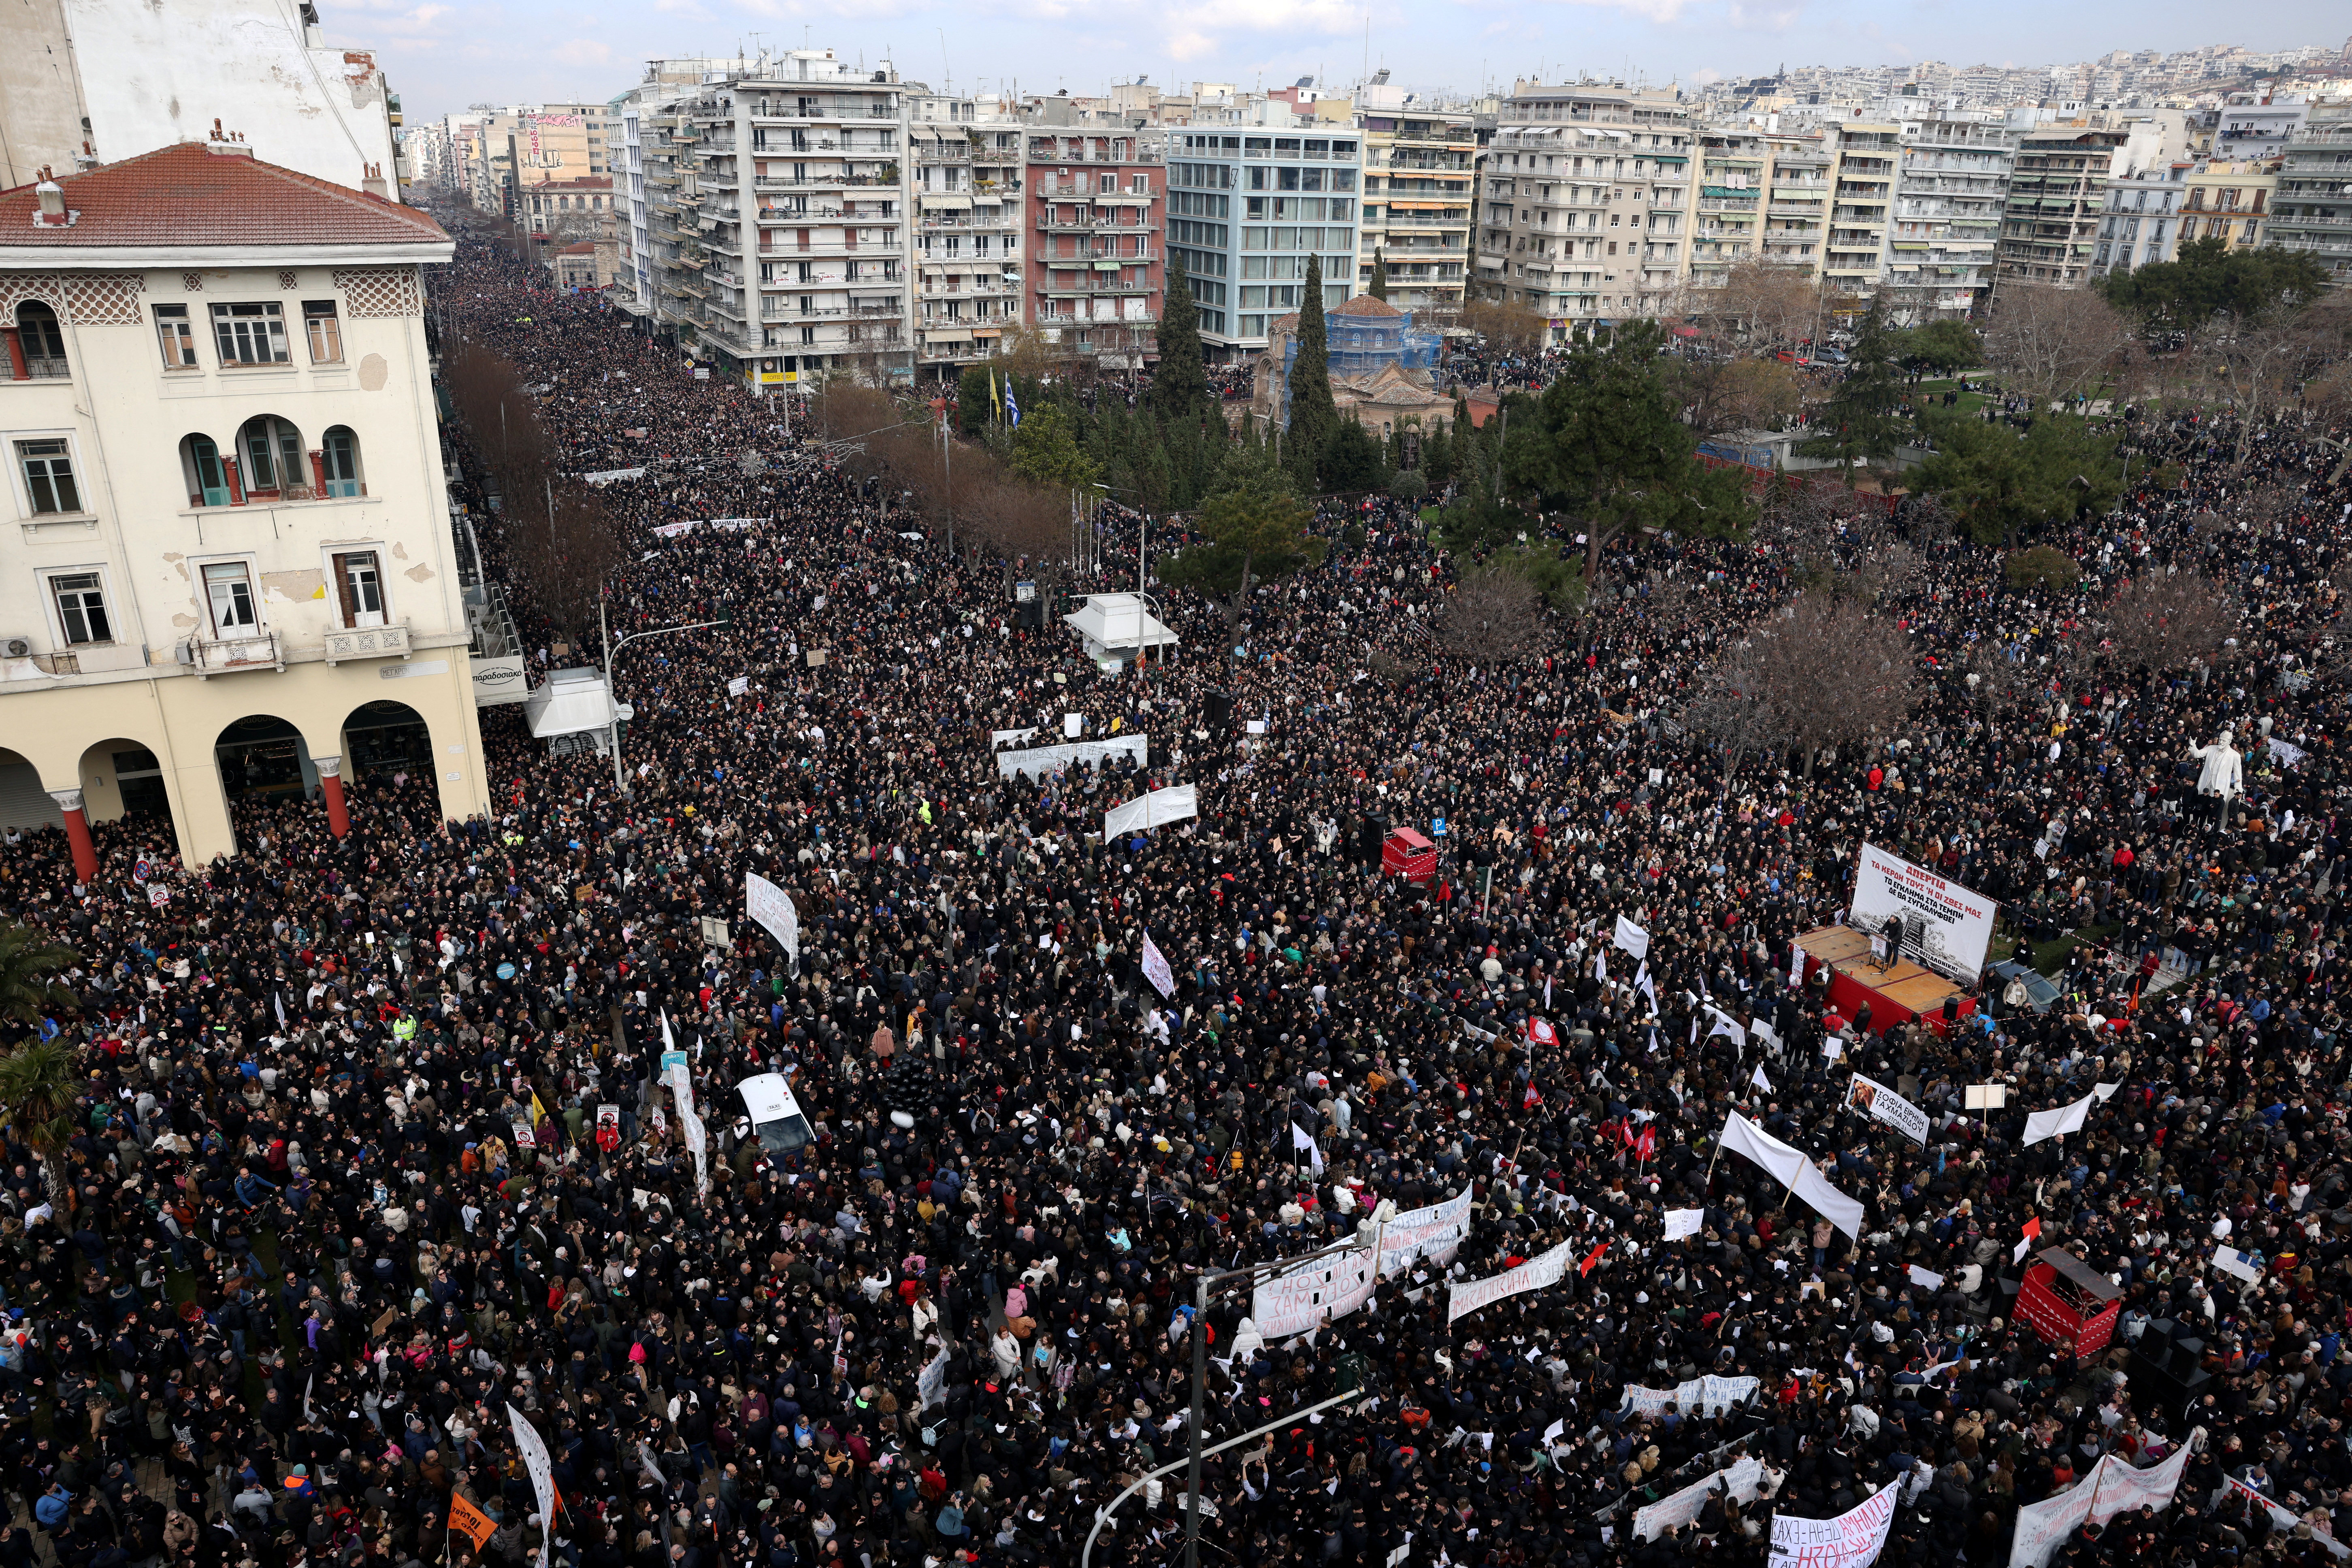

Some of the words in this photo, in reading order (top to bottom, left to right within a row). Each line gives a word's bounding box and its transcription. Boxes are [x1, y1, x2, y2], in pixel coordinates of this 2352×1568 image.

[383, 666, 410, 677] ΜΕΓΑΡΟΝ
[472, 669, 522, 682] παραδοσιακό
[1436, 820, 1442, 829] P
[1871, 860, 1880, 870] ΤΑ
[1881, 865, 1904, 882] ΚΕΡΔΗ
[1905, 877, 1924, 891] ΤΟΥΣ
[1935, 891, 1942, 901] ΟΙ
[1943, 896, 1963, 910] ΖΩΕΣ
[1965, 905, 1982, 919] ΜΑΣ
[1906, 866, 1946, 891] ΑΠΕΡΓΙΑ
[1884, 876, 1892, 885] ΤΟ
[1893, 882, 1924, 901] ΕΓΚΛΗΜΑ
[1925, 897, 1937, 908] ΣΤΑ
[1939, 903, 1964, 920] ΤΕΜΠΗ
[1889, 887, 1896, 897] ΔΕ
[1897, 891, 1907, 902] ΘΑ
[1907, 896, 1956, 925] ΣΥΓΚΑΛΥΦΘΕΙ
[1919, 947, 1959, 973] ΘΕΣΣΑΛΟΝΙΚΗΣ
[1875, 1097, 1923, 1133] ΤΑΧΜΑΖΙΔΟΥ
[1877, 1090, 1902, 1110] ΣΟΦΙΑ
[1903, 1106, 1925, 1128] ΕΙΡΗΝΗ
[1888, 1115, 1901, 1127] ΕΤΩΝ
